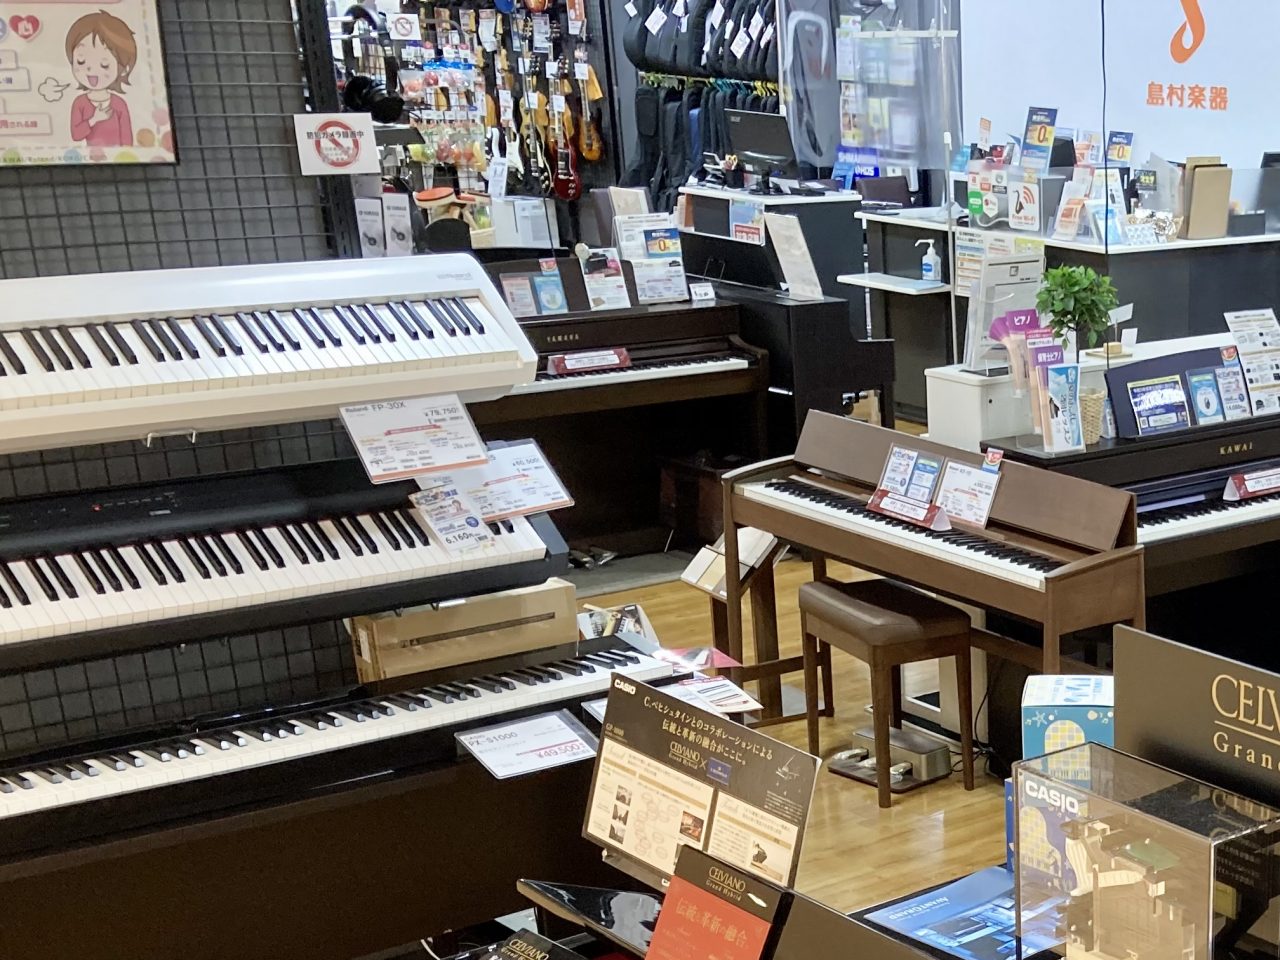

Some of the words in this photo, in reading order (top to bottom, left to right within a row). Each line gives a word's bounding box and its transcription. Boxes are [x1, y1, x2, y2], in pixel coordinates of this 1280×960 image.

[1146, 81, 1229, 111] 島村楽器
[1013, 315, 1031, 326] ピアノ
[372, 401, 406, 412] FP-30X
[1219, 442, 1253, 455] KAWAI
[614, 678, 637, 695] CASIO
[468, 731, 519, 748] PX-S1000
[662, 719, 748, 767] 伝統と革新の融合がここに。
[669, 740, 700, 763] CELVIANO
[1025, 780, 1081, 814] CASIO
[705, 879, 723, 894] Grand
[723, 887, 743, 902] Hybrid
[708, 866, 746, 892] CELVIANO
[675, 897, 748, 949] 伝統と革新の融合
